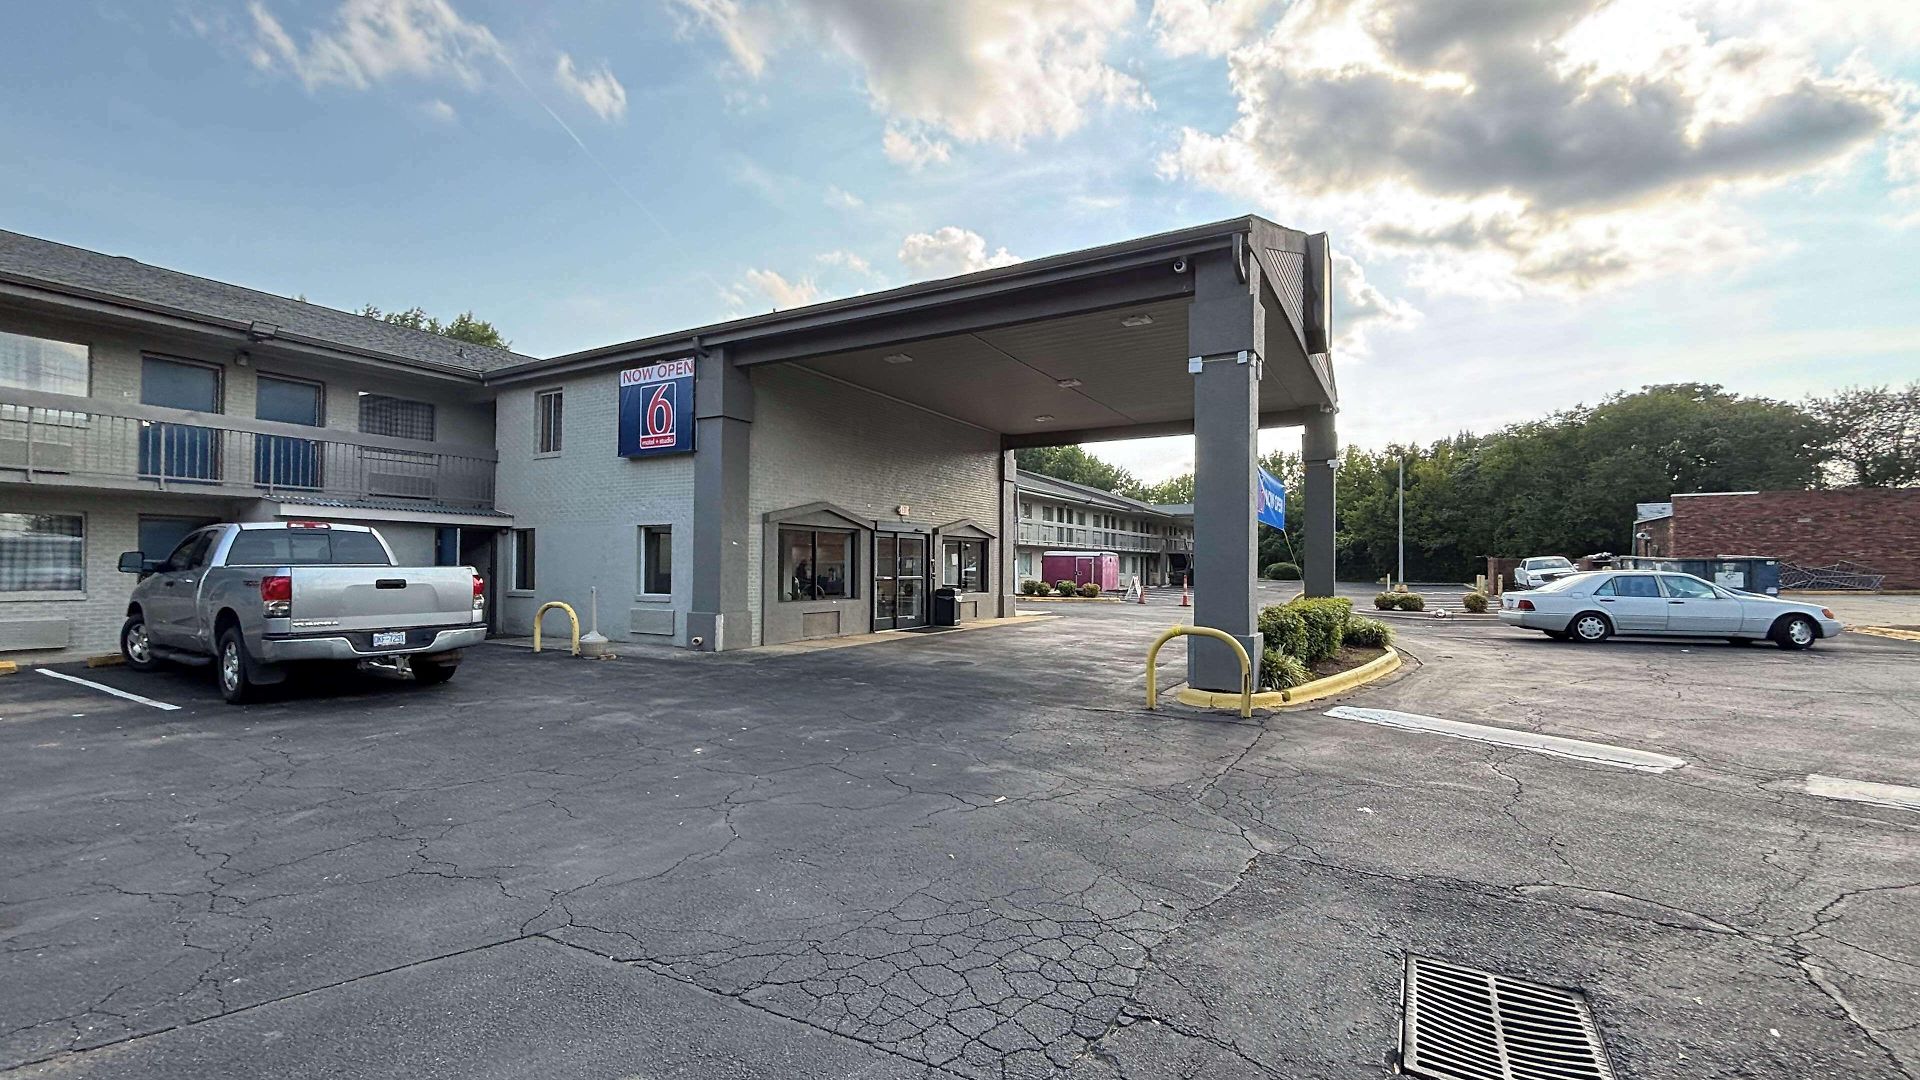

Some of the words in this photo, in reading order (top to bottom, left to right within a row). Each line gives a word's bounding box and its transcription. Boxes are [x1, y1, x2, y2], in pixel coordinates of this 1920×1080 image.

[623, 368, 654, 384] NOW
[657, 360, 694, 378] OPEN
[646, 383, 673, 436] 6
[641, 437, 655, 446] motel
[659, 436, 674, 445] studio
